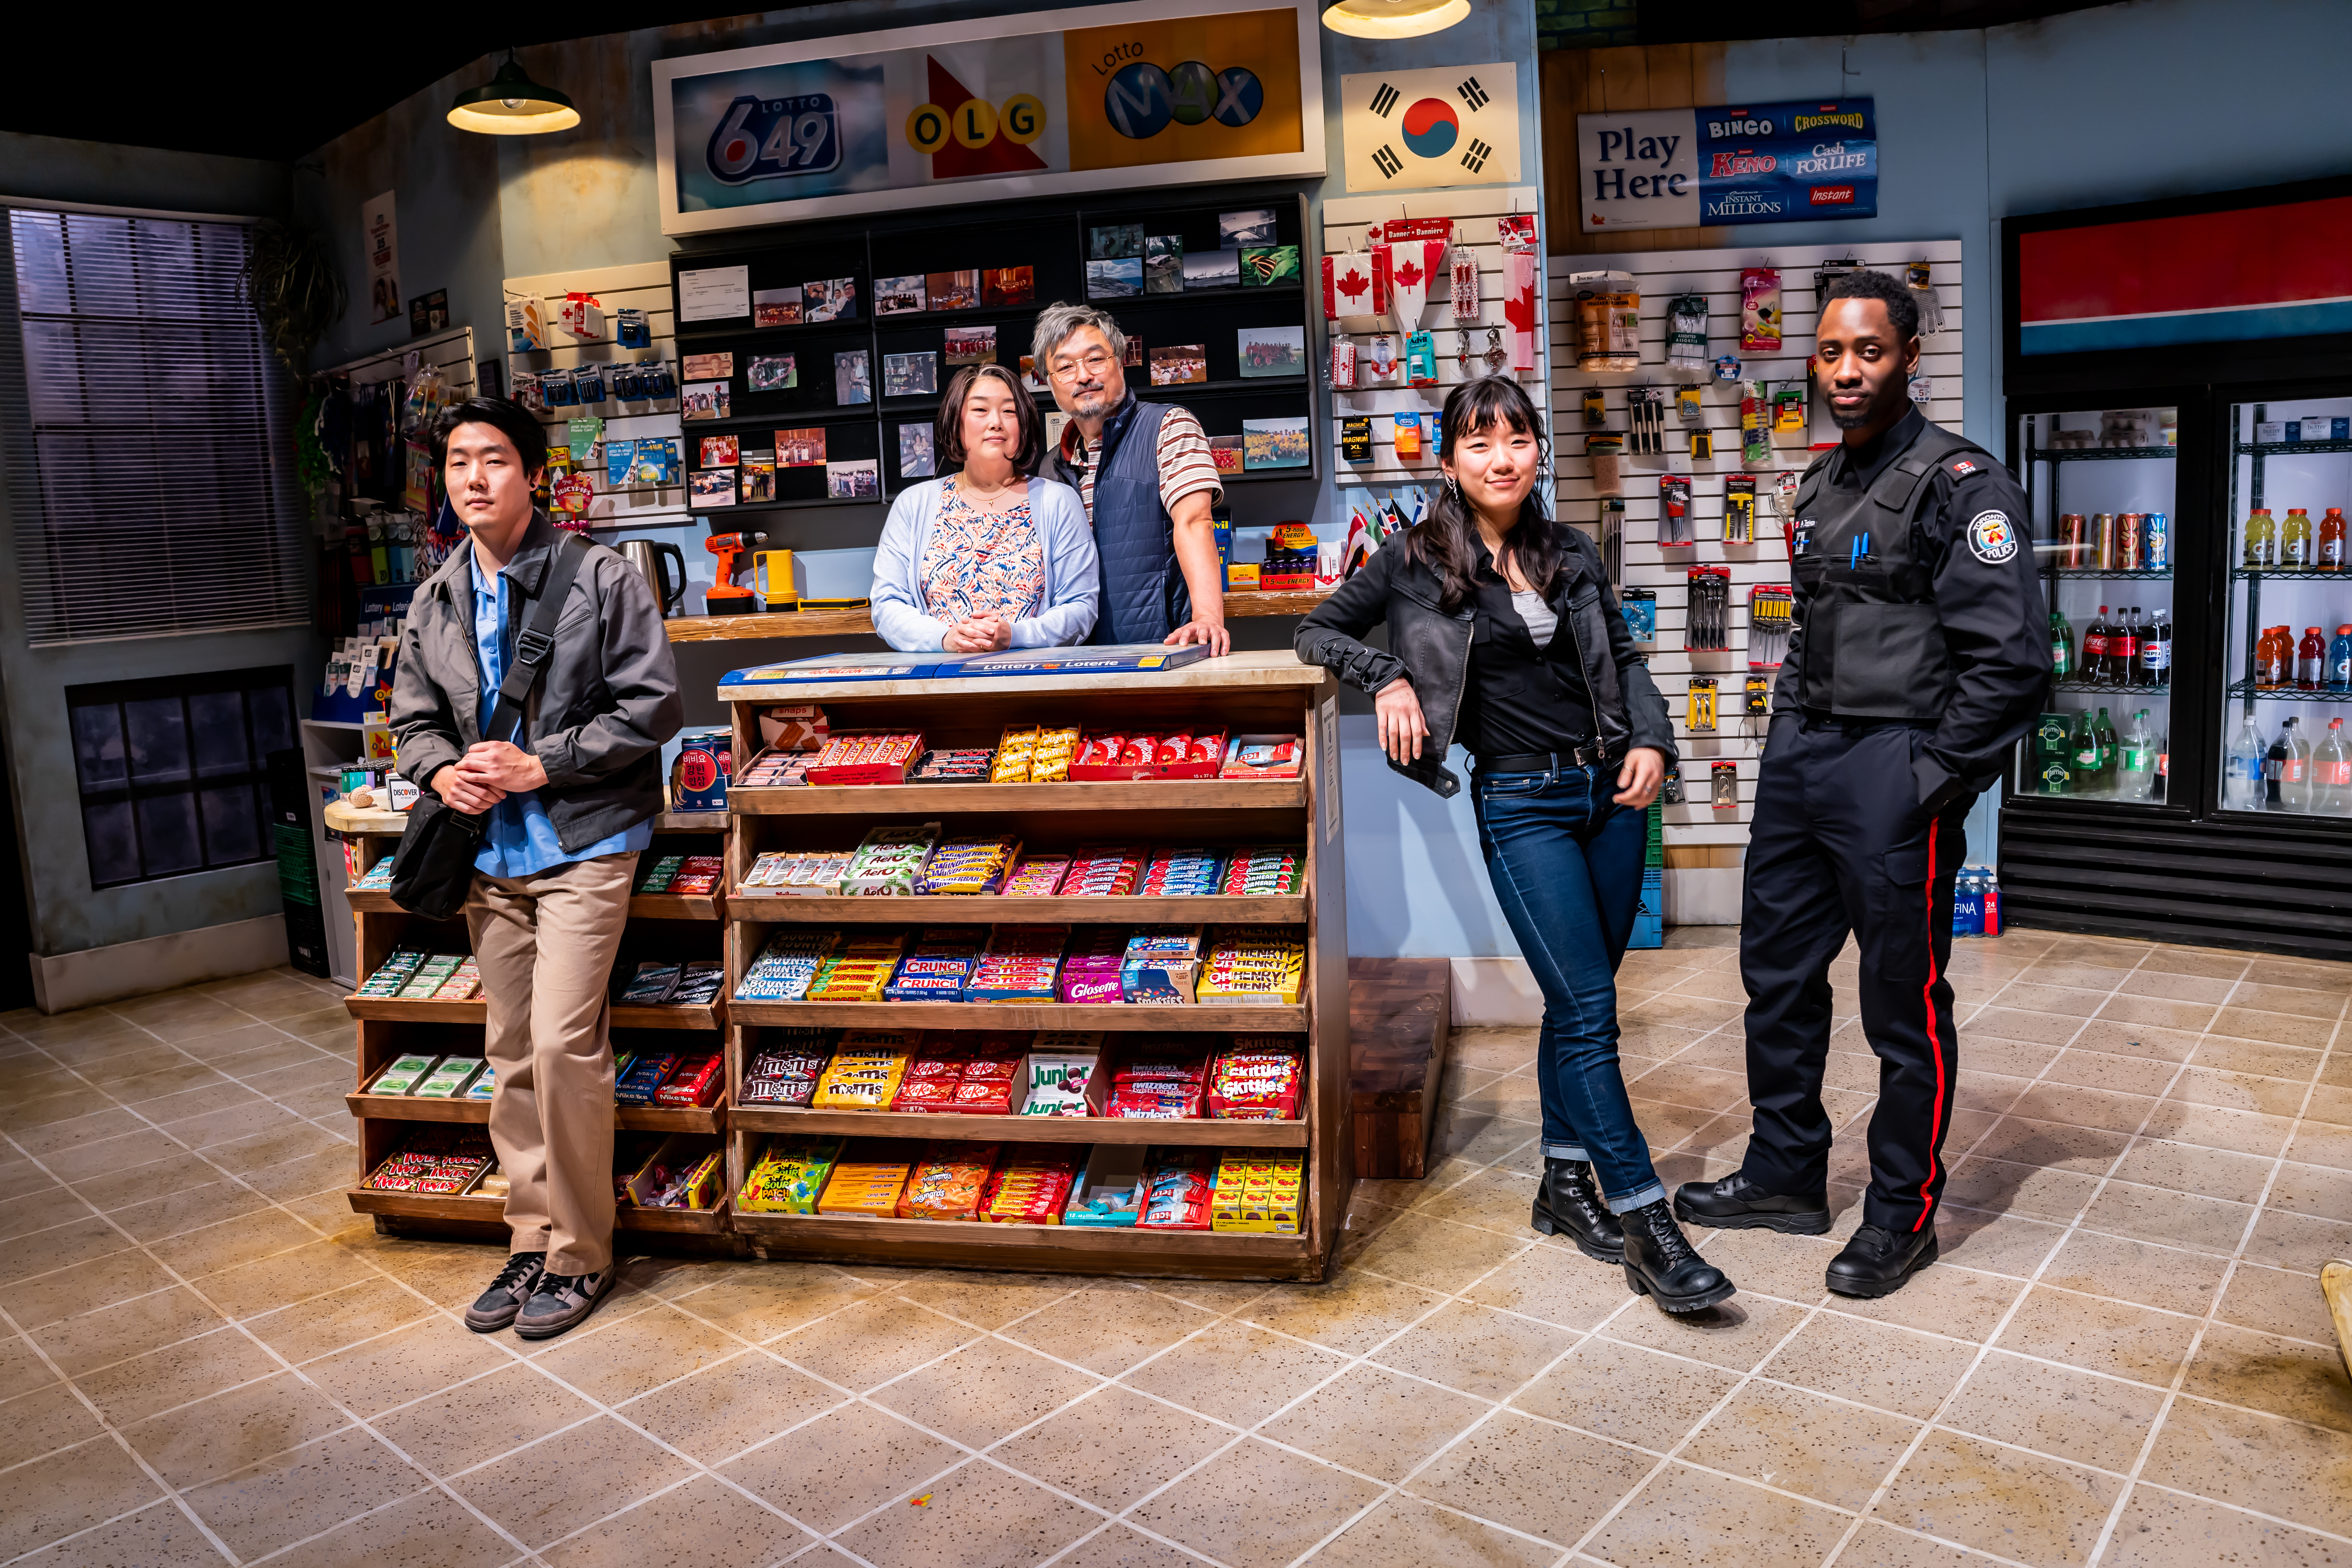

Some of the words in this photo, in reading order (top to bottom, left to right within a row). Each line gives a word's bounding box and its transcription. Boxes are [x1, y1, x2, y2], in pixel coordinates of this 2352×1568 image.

[1092, 42, 1143, 77] Lotto
[762, 96, 819, 113] LOTTO
[1112, 63, 1252, 136] MAX
[915, 102, 1035, 144] OLG
[1795, 113, 1863, 133] CROSSWORD
[709, 104, 828, 175] 649
[1598, 127, 1680, 168] Play
[1813, 141, 1845, 157] Cash
[1709, 153, 1776, 177] KENO
[1796, 159, 1826, 174] FOR
[1830, 154, 1866, 170] LIFE
[1595, 168, 1688, 200] Here
[1812, 190, 1851, 201] Instant
[1708, 202, 1781, 215] MILLIONS
[1972, 514, 2006, 530] TORONTO
[1987, 543, 2013, 558] POLICE
[365, 603, 383, 614] Lottery
[2086, 636, 2109, 645] Coca-Cola
[683, 755, 706, 764] 비비요
[687, 764, 705, 775] 강한
[689, 776, 705, 786] 인삼
[1132, 772, 1150, 781] Maltesers
[869, 856, 905, 864] Aero
[1090, 856, 1123, 866] AIRHEADS
[859, 869, 896, 878] Aero
[1165, 865, 1199, 873] AIRHEADS
[1247, 865, 1280, 873] AIRHEADS
[1954, 902, 1976, 915] FINA
[907, 962, 965, 973] CRUNCH
[899, 979, 957, 988] CRUNCH
[1209, 972, 1232, 983] OH
[1234, 971, 1287, 984] HENRY!
[1071, 981, 1118, 998] Glosette
[914, 1063, 944, 1075] KitKat
[1229, 1064, 1291, 1077] Skittles
[959, 1086, 987, 1098] KitKat
[1223, 1079, 1286, 1098] Skittles
[430, 1168, 470, 1178] TWIX
[374, 1176, 414, 1189] TWIX
[763, 1189, 789, 1198] PATCH
